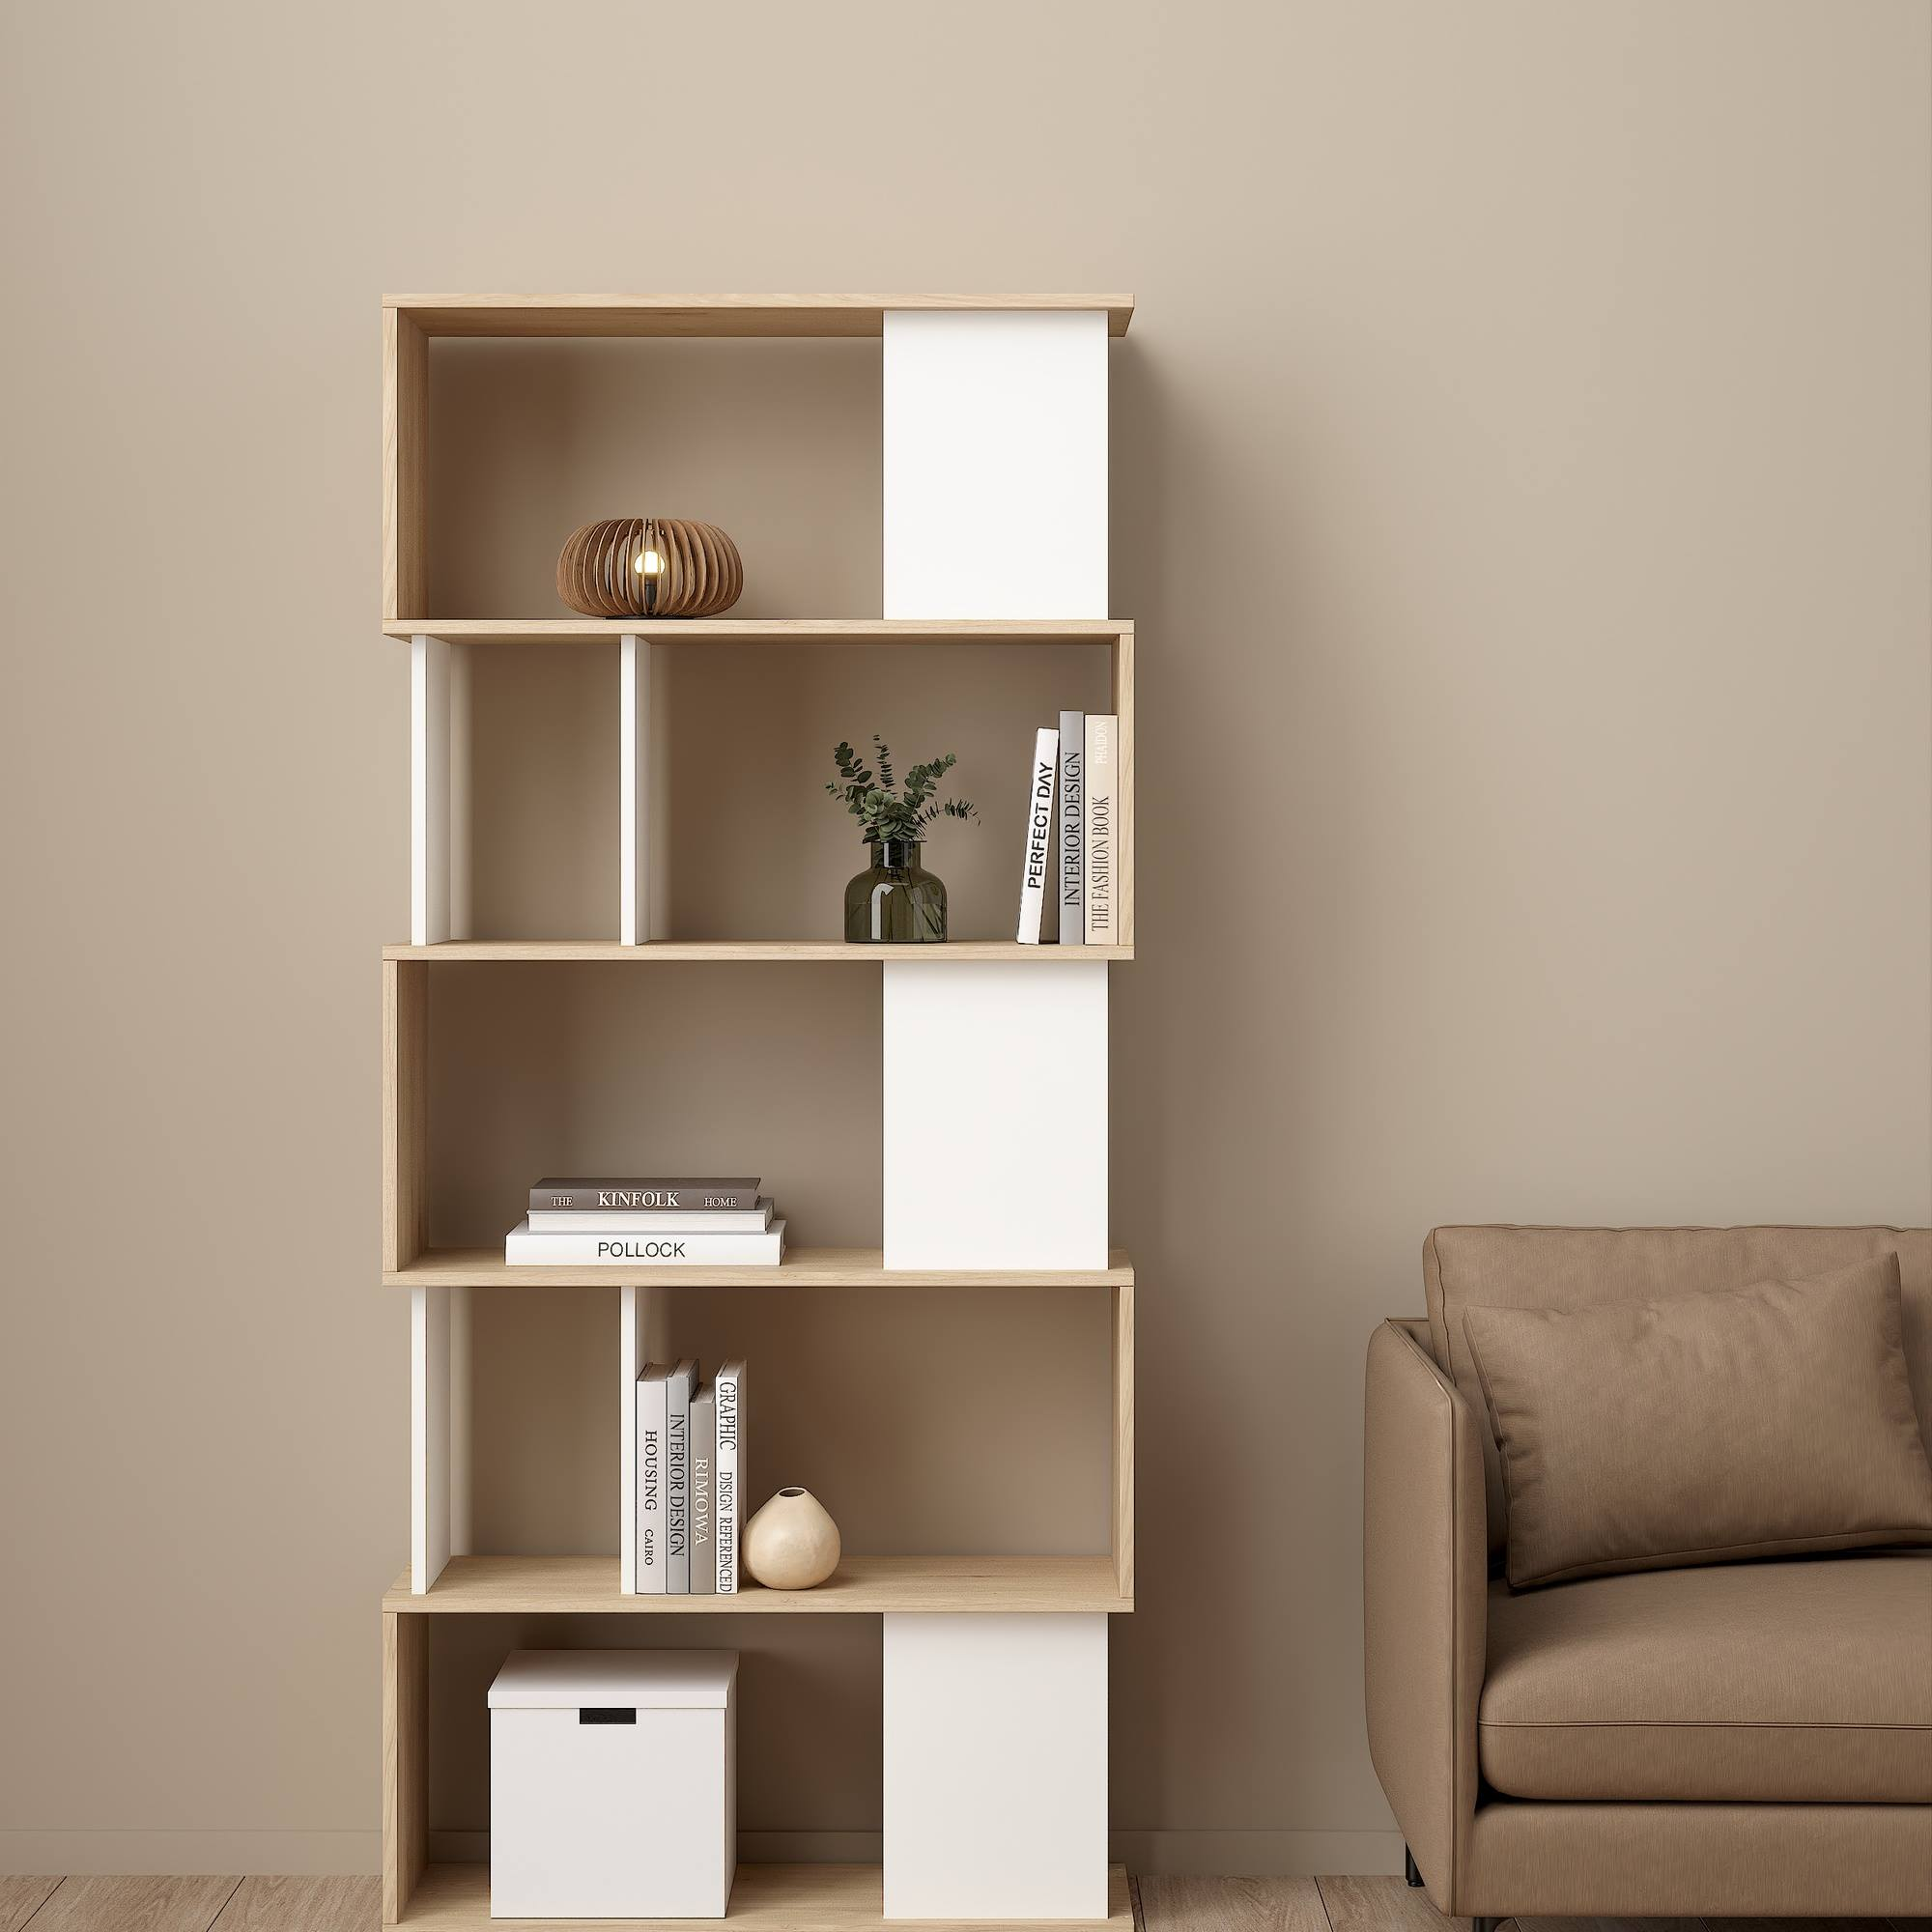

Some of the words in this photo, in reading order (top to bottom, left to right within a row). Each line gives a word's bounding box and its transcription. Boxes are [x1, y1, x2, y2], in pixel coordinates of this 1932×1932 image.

[1094, 720, 1107, 764] PHAIDON
[1037, 762, 1053, 798] DAY
[1064, 752, 1081, 817] DESIGN
[1027, 803, 1050, 889] PERFECT
[1092, 795, 1109, 836] BOOK
[1064, 823, 1080, 906] INTERIOR
[1091, 838, 1109, 899] FASHION
[1091, 903, 1109, 932] THE
[551, 1196, 573, 1207] THE
[597, 1190, 680, 1208] KINFOLK
[703, 1197, 737, 1208] HOME
[597, 1241, 686, 1258] POLLOCK
[719, 1381, 737, 1451] GRAPHIC
[644, 1430, 658, 1511] HOUSING
[669, 1414, 685, 1492] INTERIOR
[695, 1457, 709, 1547] RIMOWA
[719, 1471, 732, 1517] DISIGN
[644, 1528, 654, 1566] CAIRO
[669, 1495, 685, 1557] DESIGN
[719, 1517, 732, 1593] REFERENCED
